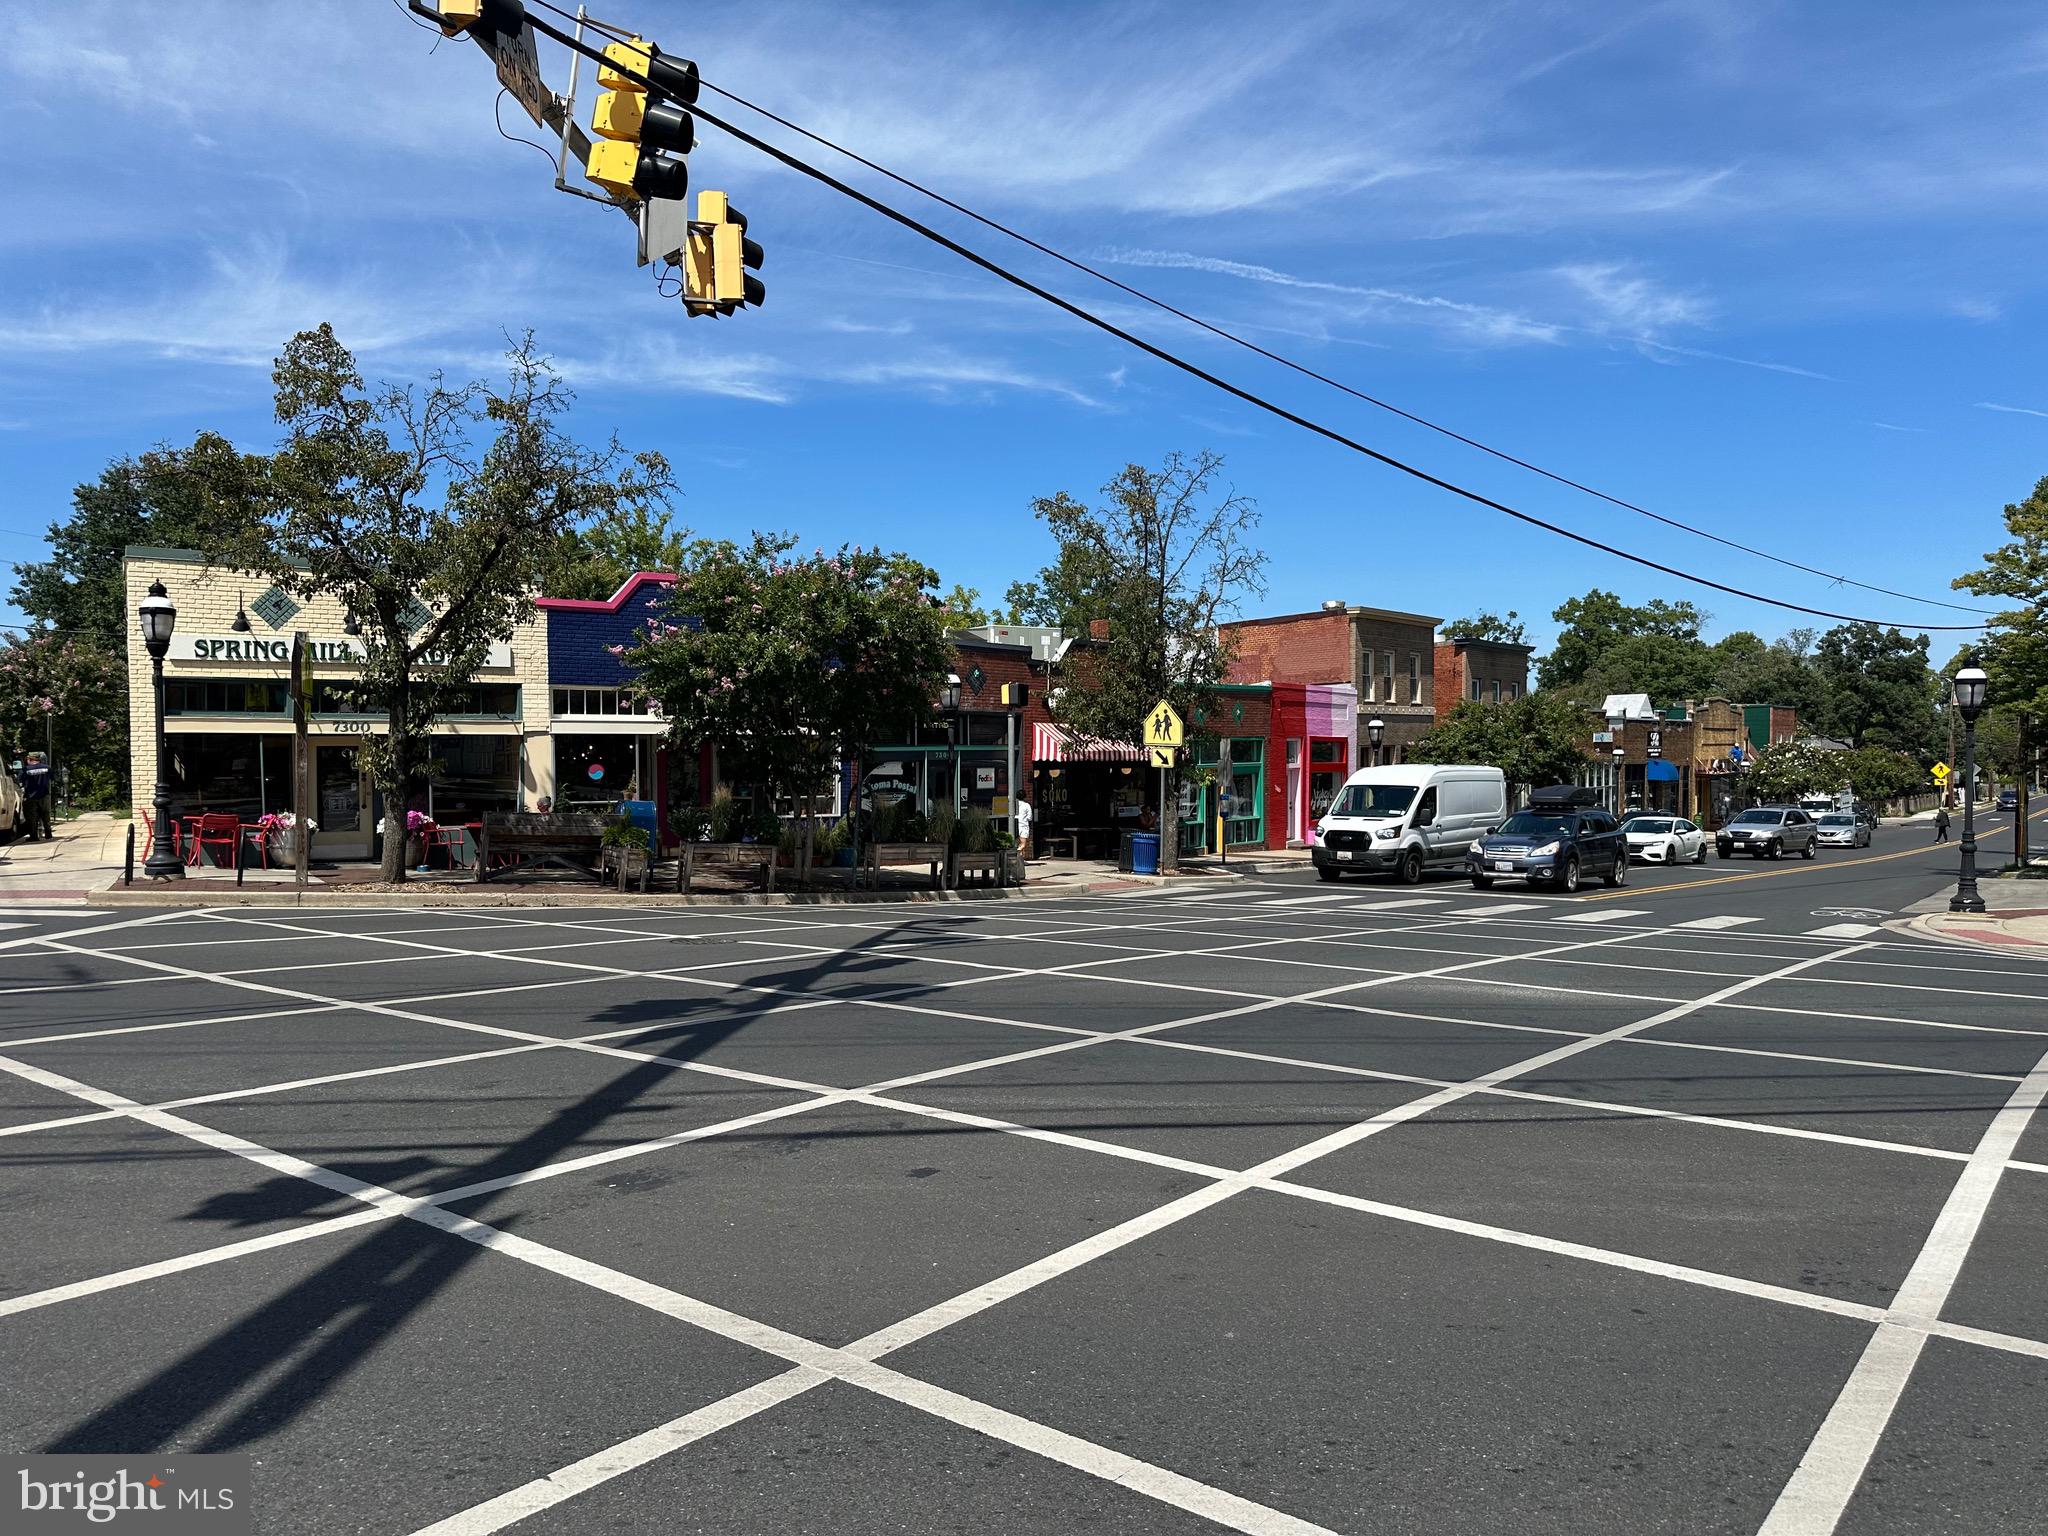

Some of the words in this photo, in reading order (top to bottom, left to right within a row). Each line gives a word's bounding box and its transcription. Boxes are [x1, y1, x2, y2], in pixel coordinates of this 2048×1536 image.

[501, 46, 517, 78] ON
[521, 71, 538, 104] RED
[193, 638, 288, 660] SPRING
[334, 721, 371, 733] 7300
[978, 774, 993, 783] FedEx
[892, 779, 918, 794] Postal
[1042, 788, 1068, 803] SOKO
